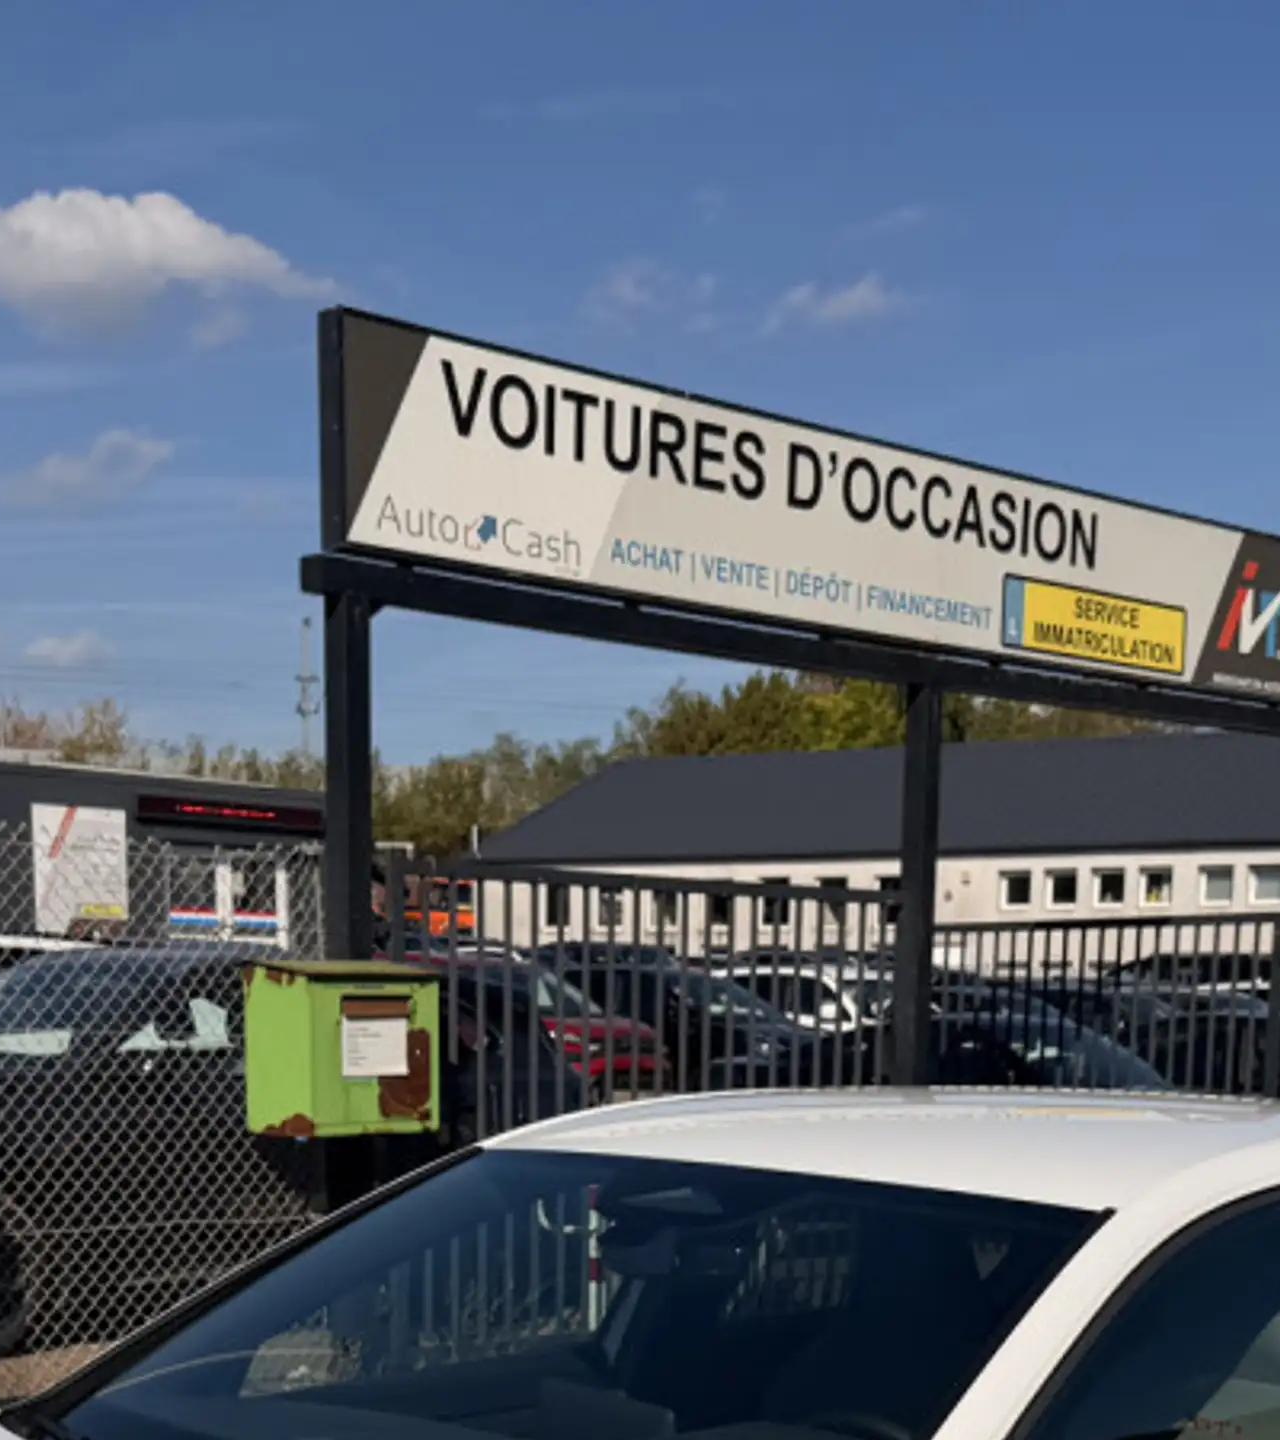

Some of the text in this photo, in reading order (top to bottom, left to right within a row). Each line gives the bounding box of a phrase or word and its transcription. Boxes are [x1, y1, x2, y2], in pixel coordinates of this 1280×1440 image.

[440, 357, 768, 502] VOITURES
[610, 537, 684, 576] ACHAT
[699, 554, 770, 591] VENTE
[784, 569, 855, 604] DÉPÔT
[866, 583, 993, 631] FINANCEMENT
[1074, 595, 1141, 630] SERVICE
[1032, 620, 1175, 665] IMMATRICULATION
